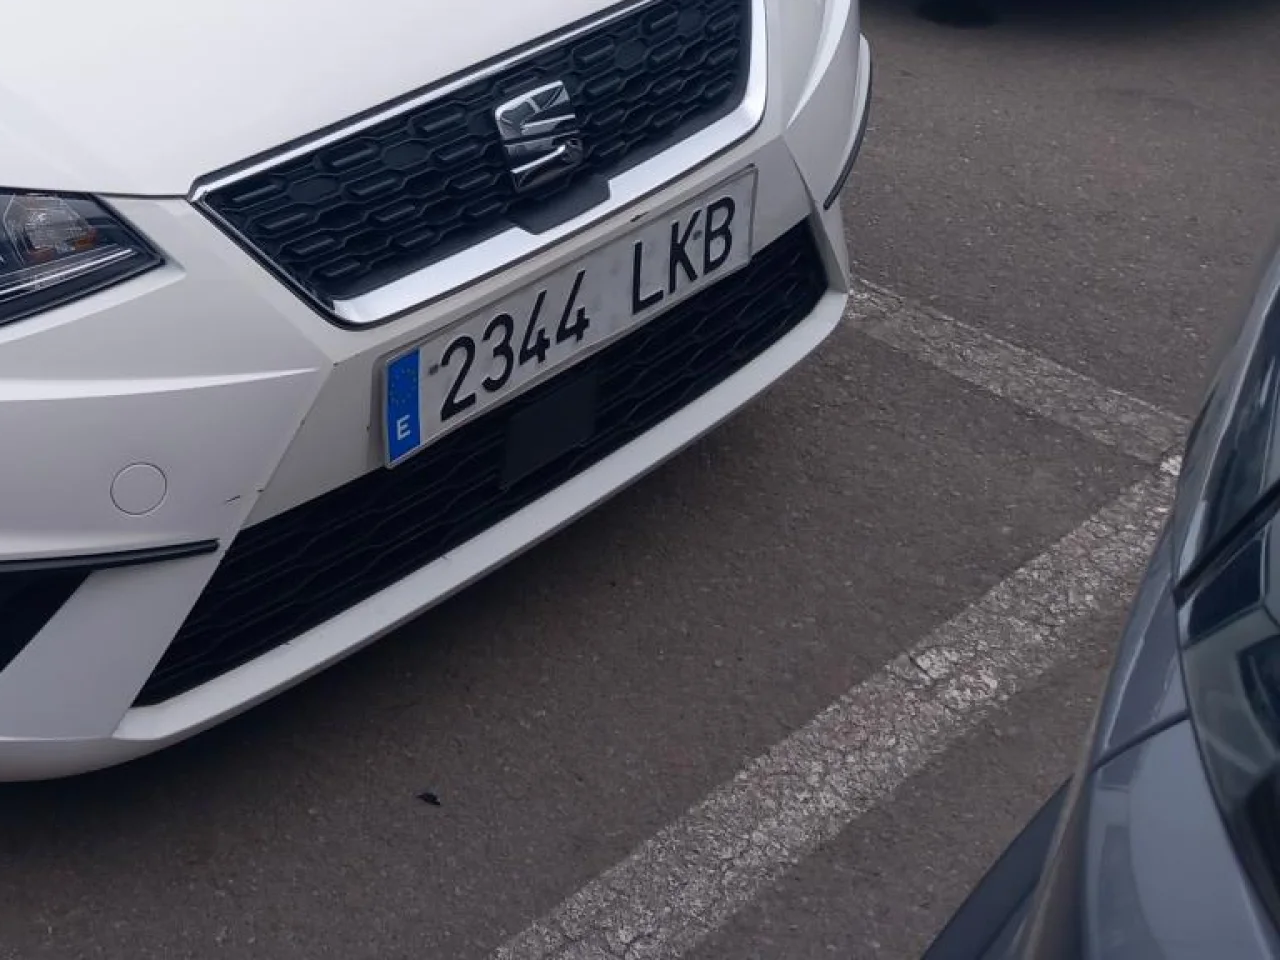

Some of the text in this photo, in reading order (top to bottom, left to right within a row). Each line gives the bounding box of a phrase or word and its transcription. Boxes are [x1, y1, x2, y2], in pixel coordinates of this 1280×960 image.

[440, 196, 736, 422] 2344 LKB
[396, 414, 411, 442] E
